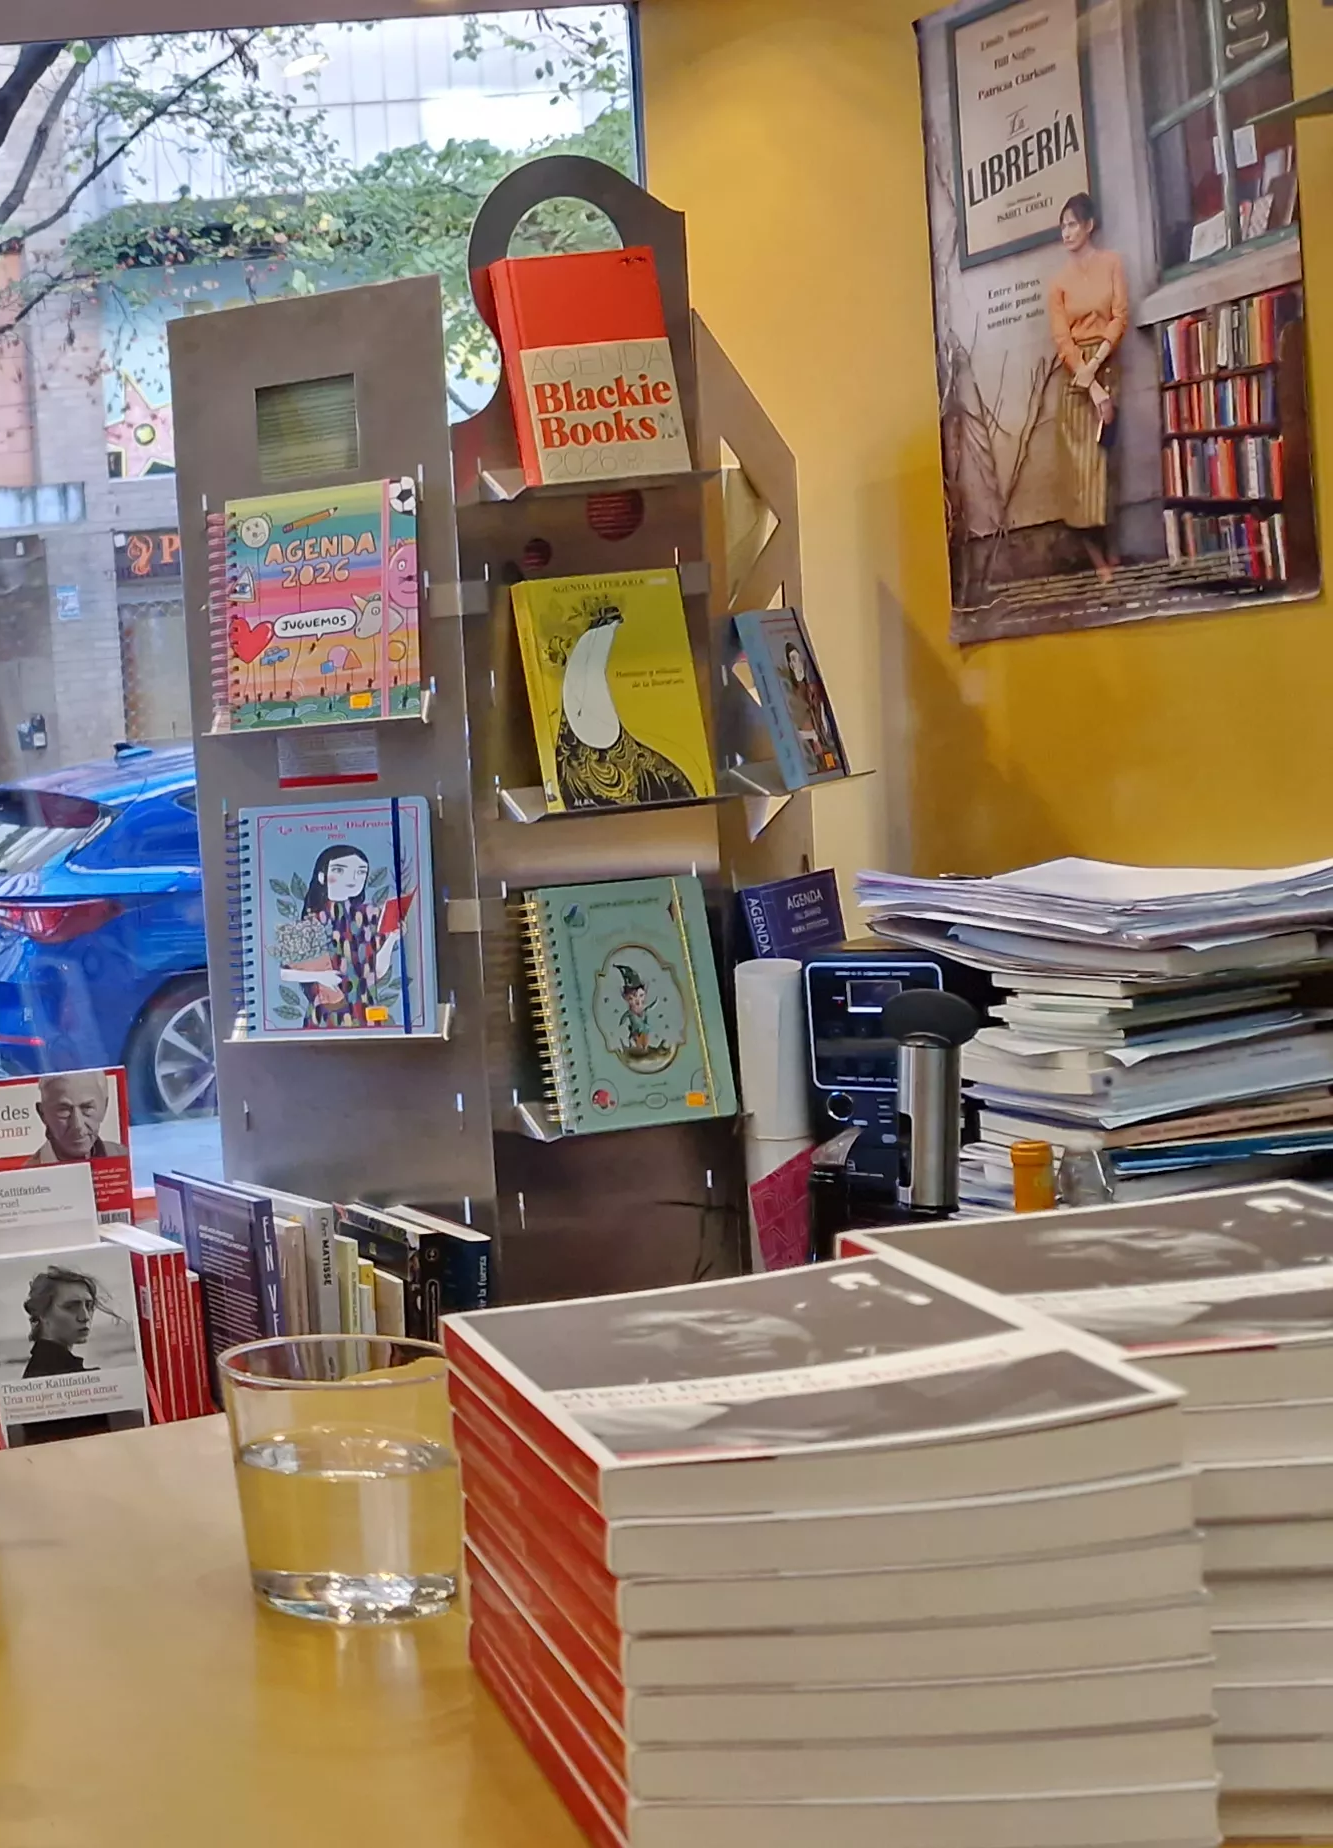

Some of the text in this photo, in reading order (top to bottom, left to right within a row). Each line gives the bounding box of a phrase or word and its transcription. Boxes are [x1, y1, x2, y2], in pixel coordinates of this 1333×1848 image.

[967, 109, 1080, 208] LIBRERÍA
[530, 343, 666, 381] AGENDA
[532, 373, 673, 416] Blackie
[537, 410, 659, 450] Books
[545, 446, 619, 479] 2026
[264, 530, 377, 566] AGENDA
[282, 557, 350, 589] 2026
[280, 614, 347, 632] JUGUEMOS
[787, 888, 824, 911] AGENDA
[747, 897, 773, 955] AGENDA
[320, 1238, 333, 1286] MATISSE
[1, 1374, 101, 1395] Theodor Kallifatides
